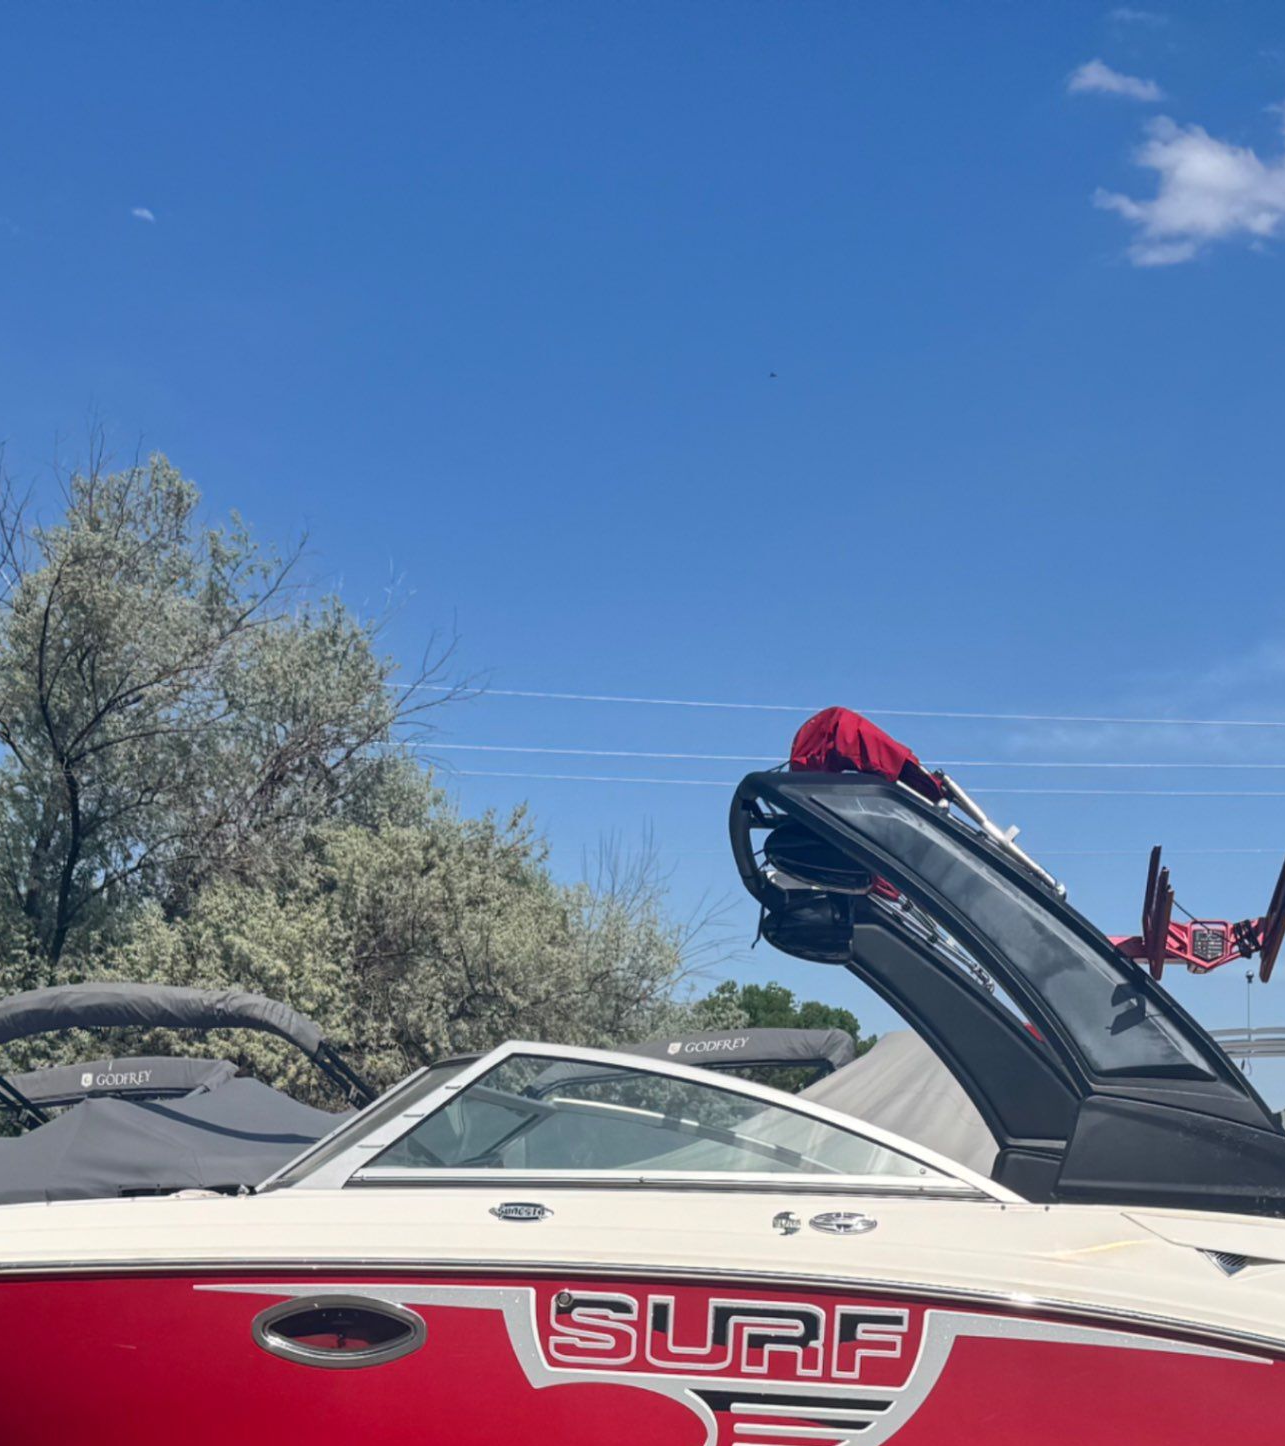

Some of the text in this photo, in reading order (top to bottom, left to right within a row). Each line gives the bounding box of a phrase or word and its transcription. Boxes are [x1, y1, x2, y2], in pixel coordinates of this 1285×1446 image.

[684, 1036, 749, 1053] GODFREY
[96, 1070, 152, 1086] GODFREY
[549, 1289, 909, 1379] SURF
